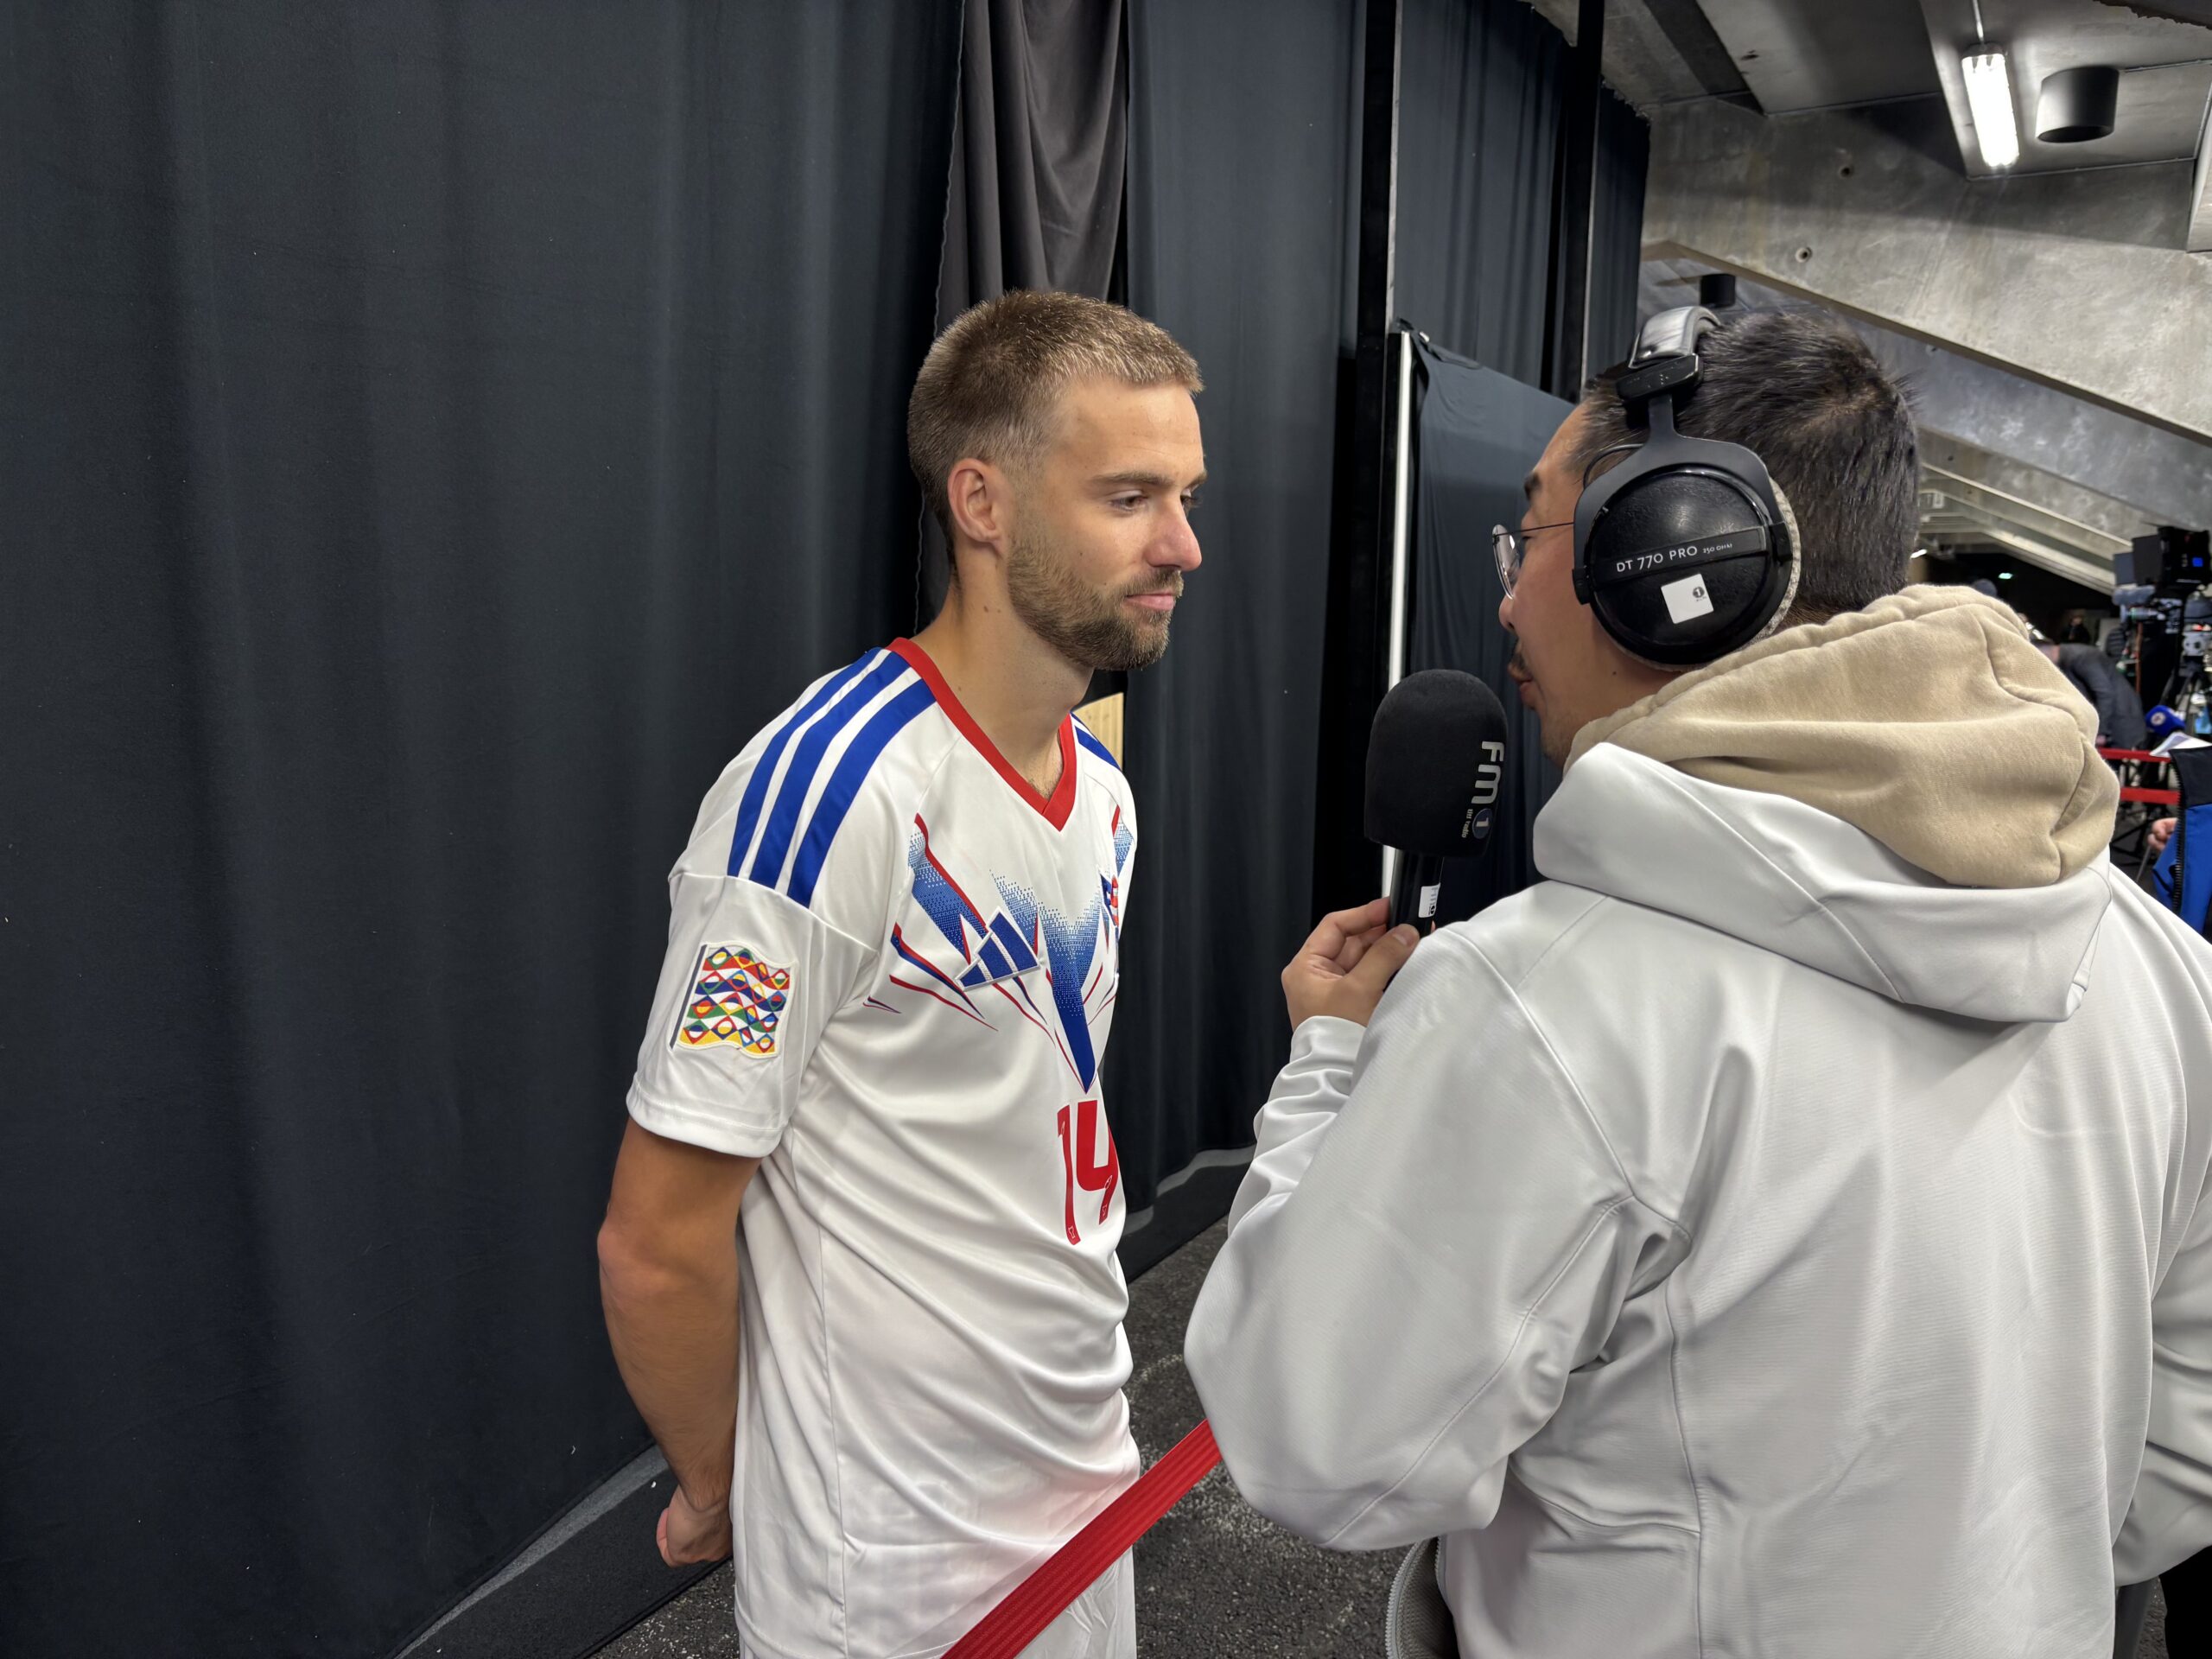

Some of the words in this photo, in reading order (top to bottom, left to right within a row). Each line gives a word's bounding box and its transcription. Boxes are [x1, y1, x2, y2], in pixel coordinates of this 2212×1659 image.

[1616, 560, 1633, 572] DT
[1637, 553, 1663, 570] 770
[1669, 545, 1698, 560] PRO
[1057, 1099, 1119, 1246] 14
